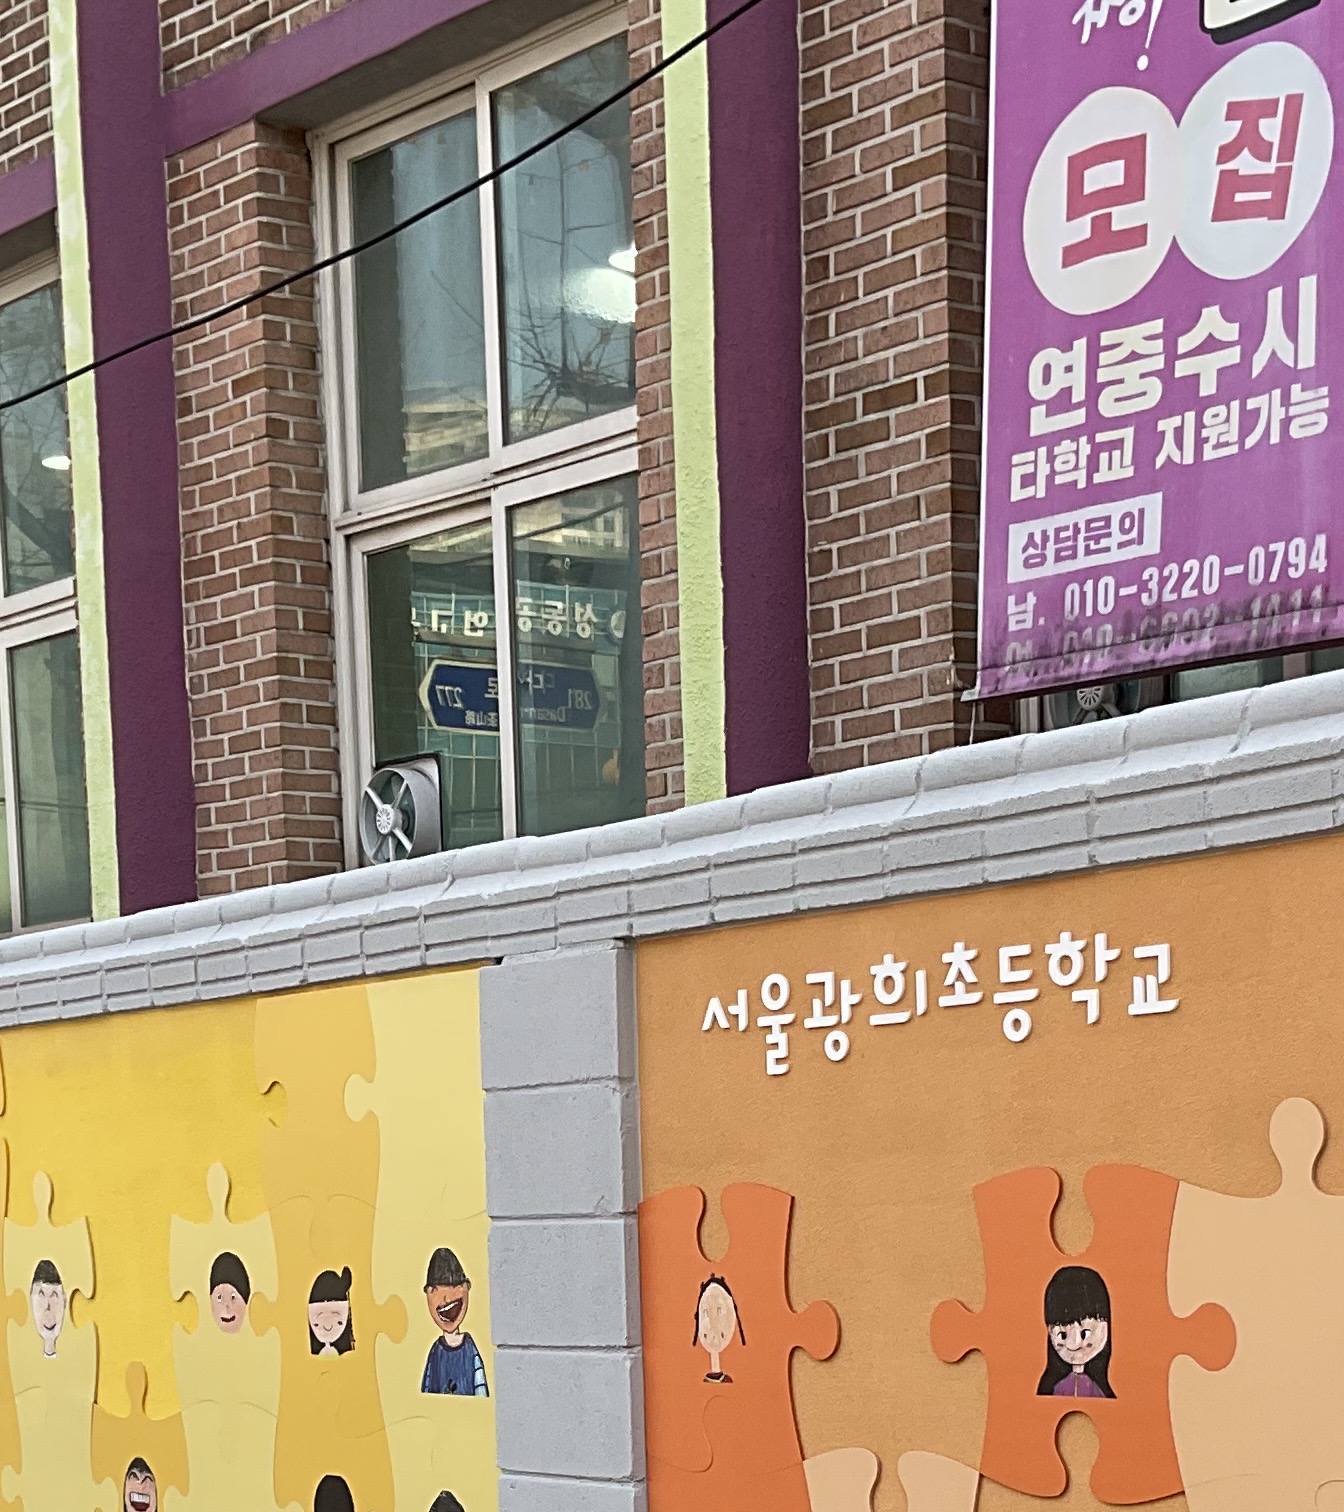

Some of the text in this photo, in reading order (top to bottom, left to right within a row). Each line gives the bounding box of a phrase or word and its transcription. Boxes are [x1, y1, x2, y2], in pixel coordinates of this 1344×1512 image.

[1061, 92, 1301, 269] 모집
[1027, 275, 1319, 437] 연중수시
[1009, 383, 1330, 502] 타학교 지원가능
[1020, 507, 1146, 570] 상담문의
[1063, 533, 1328, 622] 010-3220-0794
[701, 931, 1180, 1076] 서울광희초등학교
